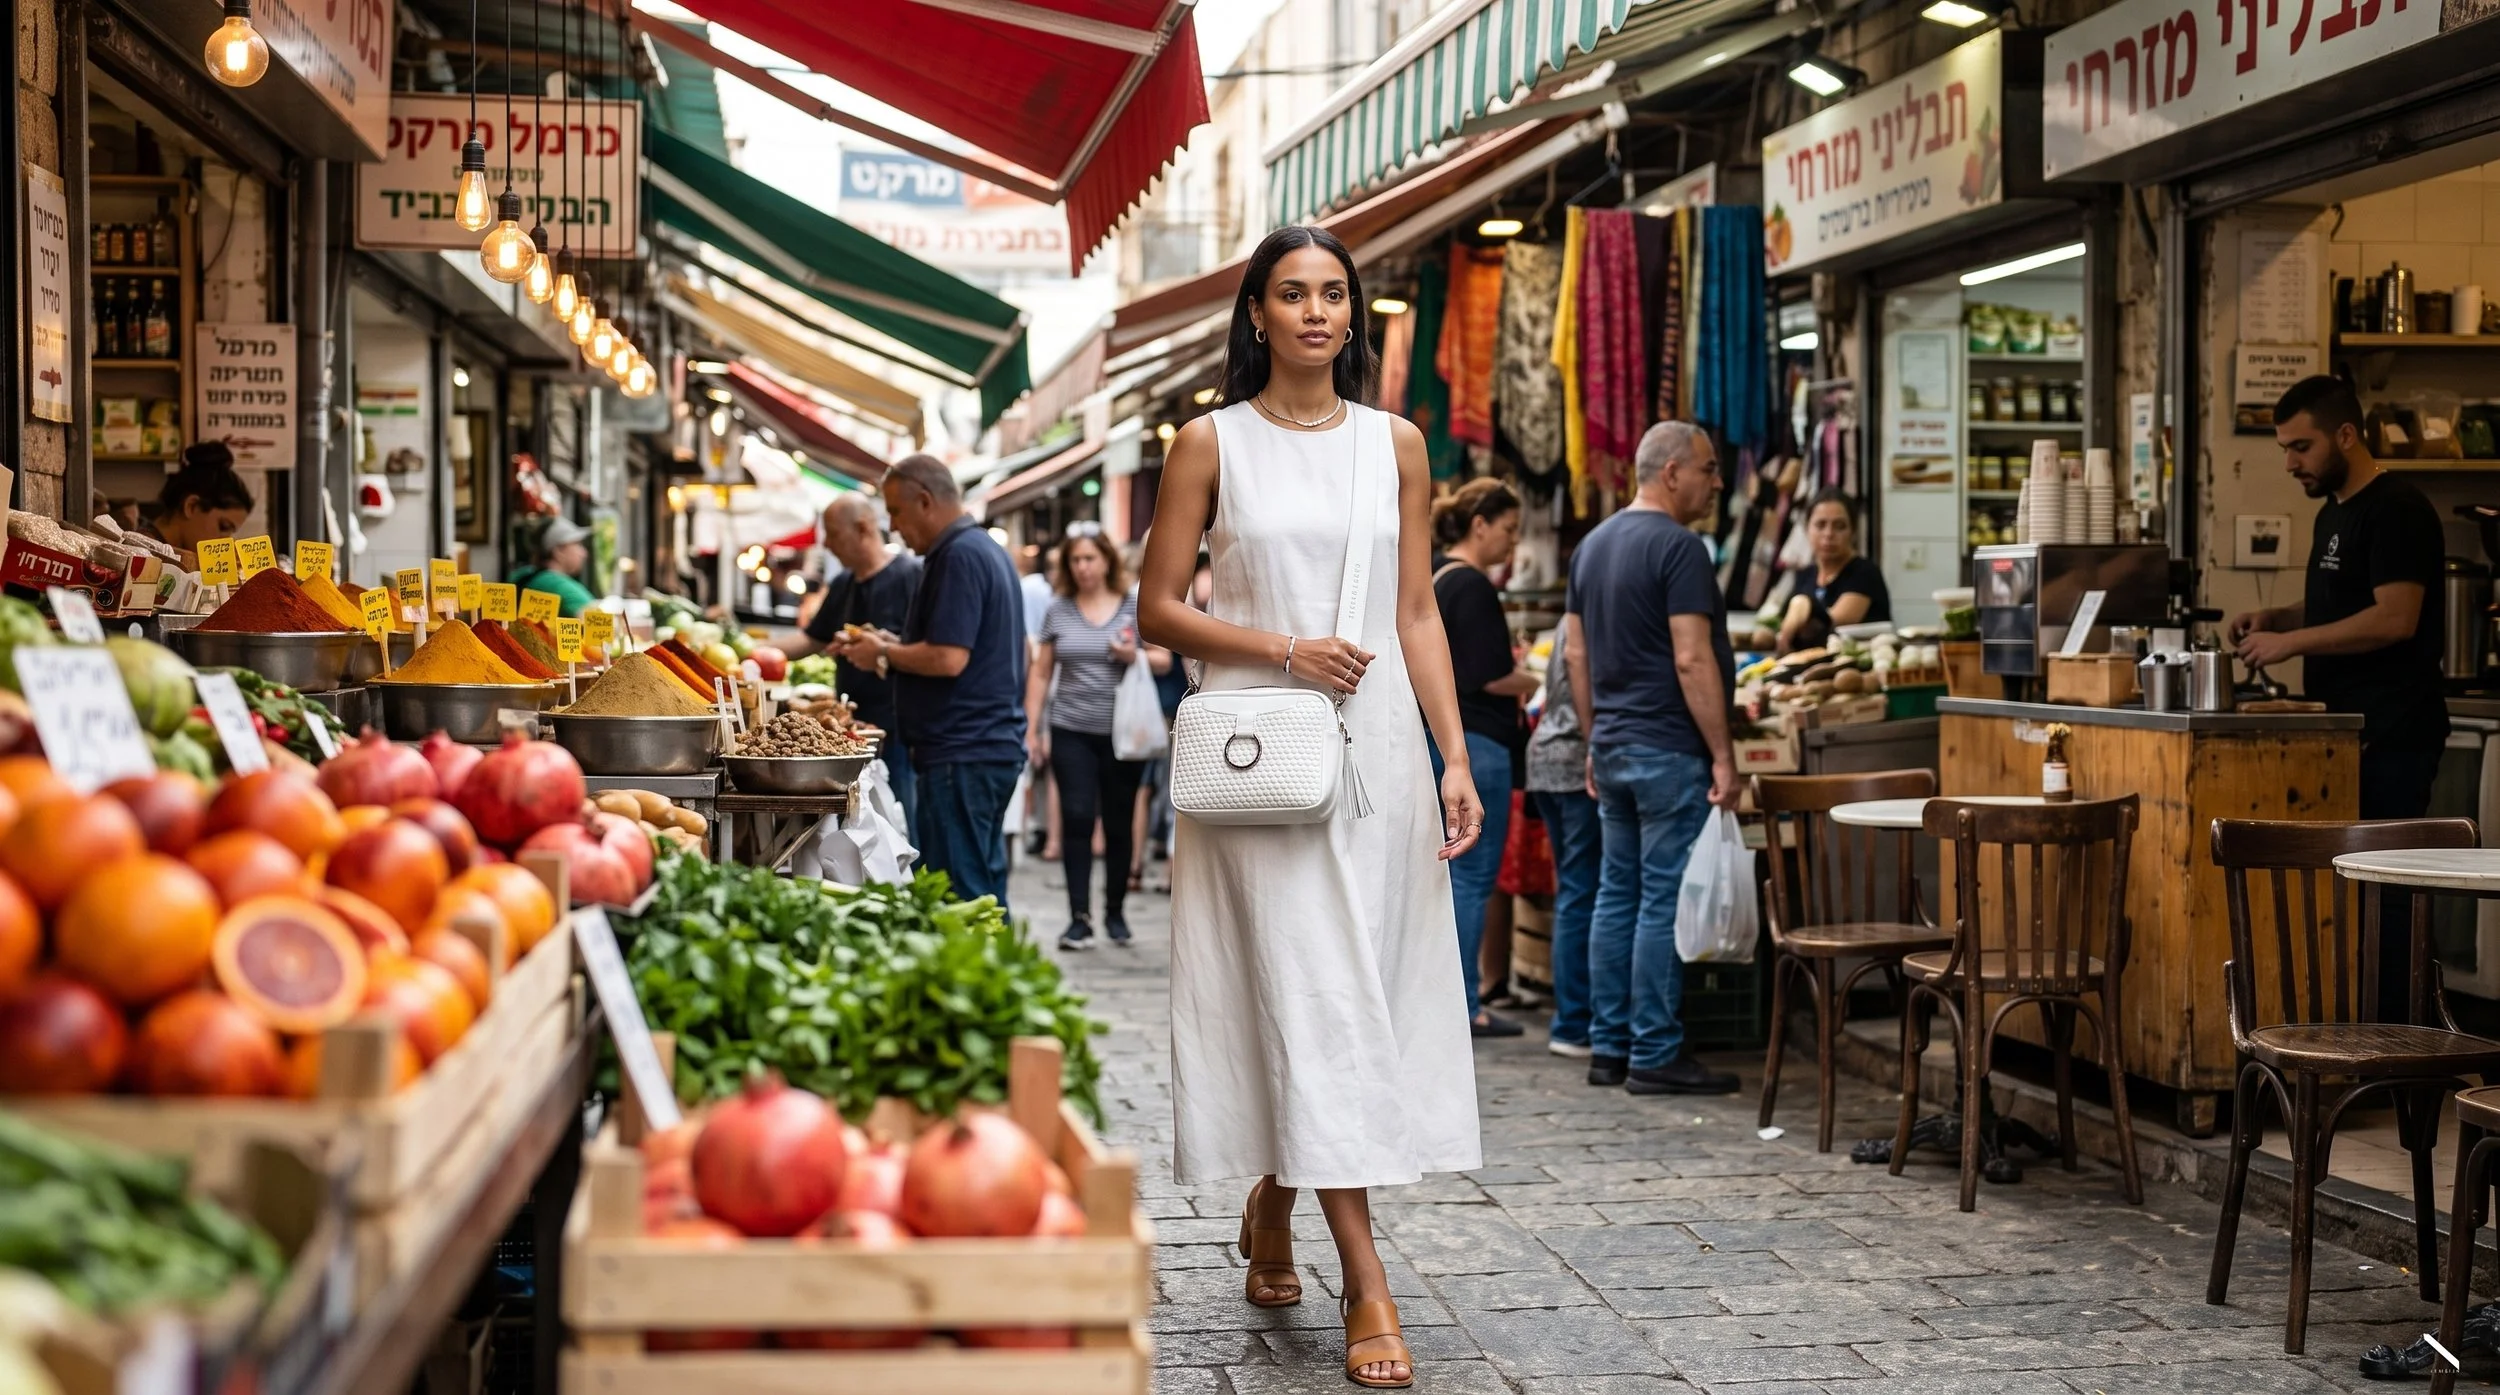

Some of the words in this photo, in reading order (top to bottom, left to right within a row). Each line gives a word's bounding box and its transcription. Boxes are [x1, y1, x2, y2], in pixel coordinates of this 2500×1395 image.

[2066, 9, 2197, 135] מזרחי
[1787, 127, 1862, 204] מזרחי
[1871, 80, 1968, 173] תבליני
